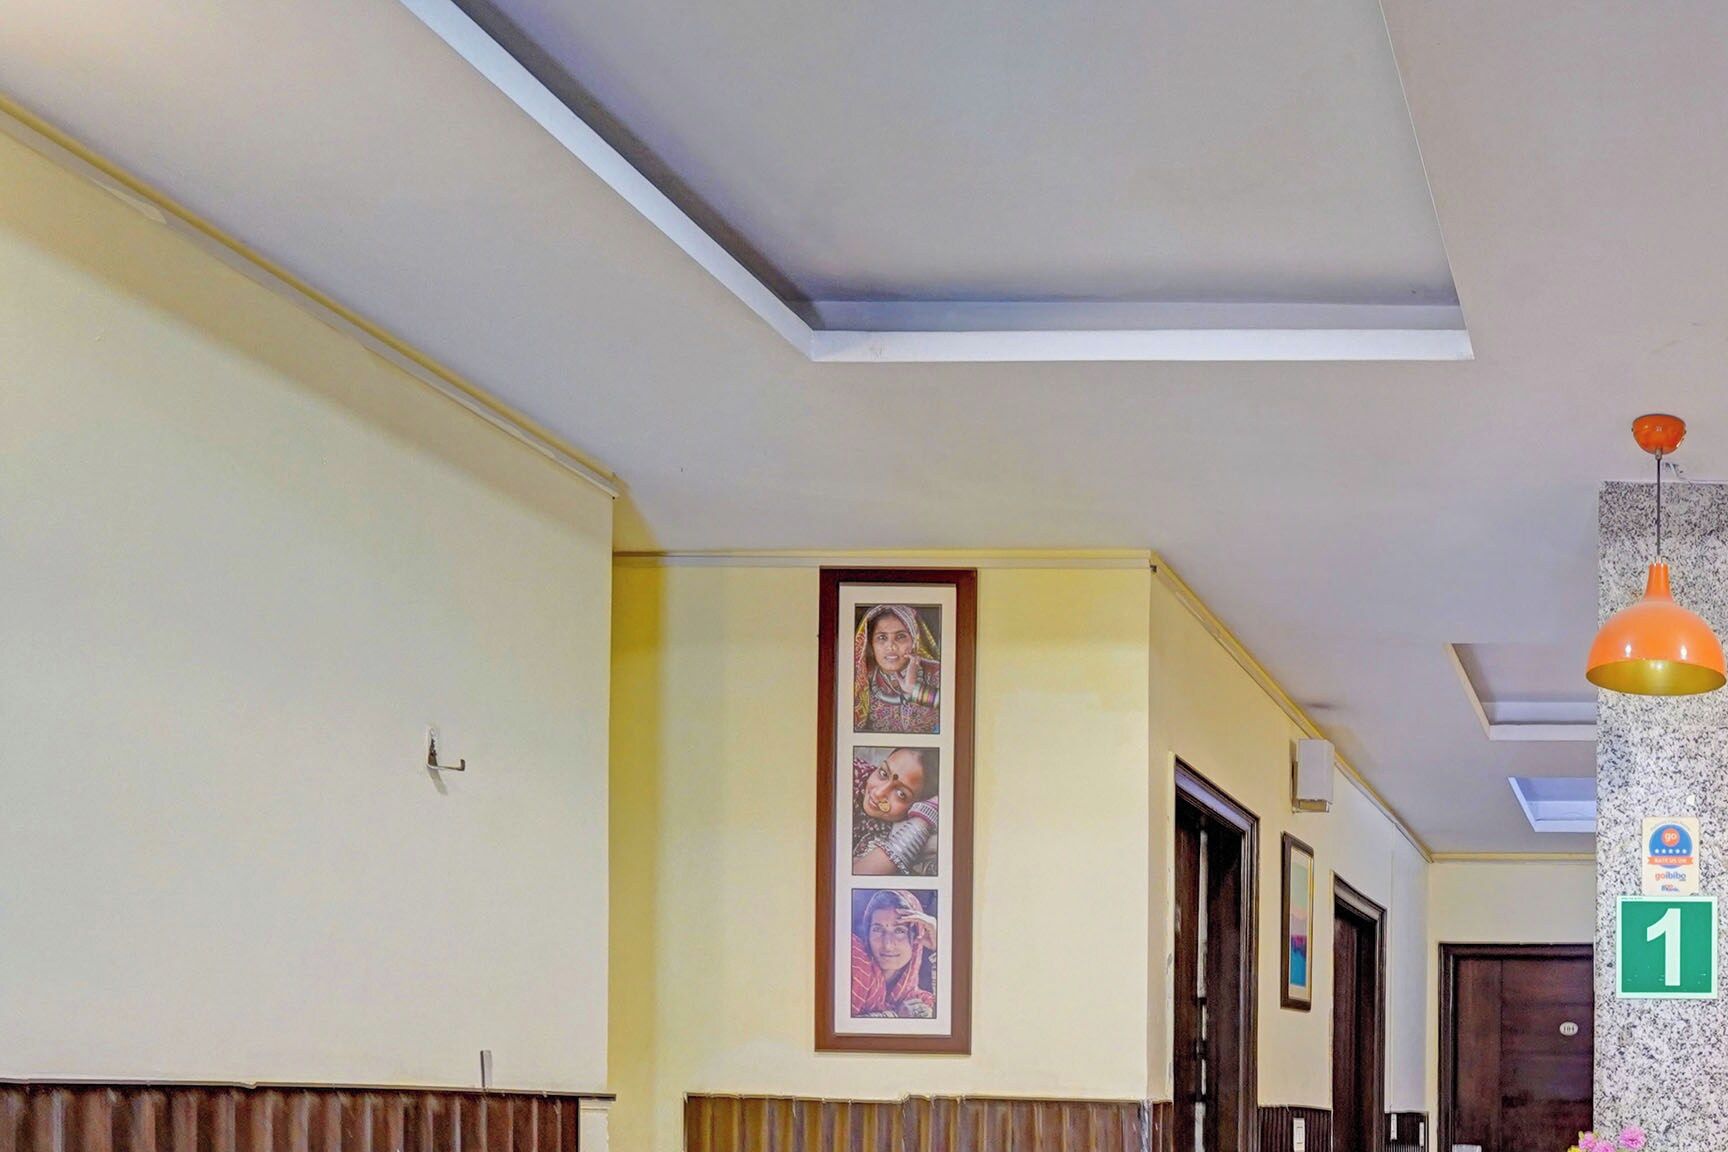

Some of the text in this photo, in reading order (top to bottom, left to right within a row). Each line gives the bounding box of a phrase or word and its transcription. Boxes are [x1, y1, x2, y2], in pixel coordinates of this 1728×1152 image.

[1664, 832, 1678, 842] go
[1655, 871, 1687, 881] goibibo
[1647, 908, 1681, 987] 1
